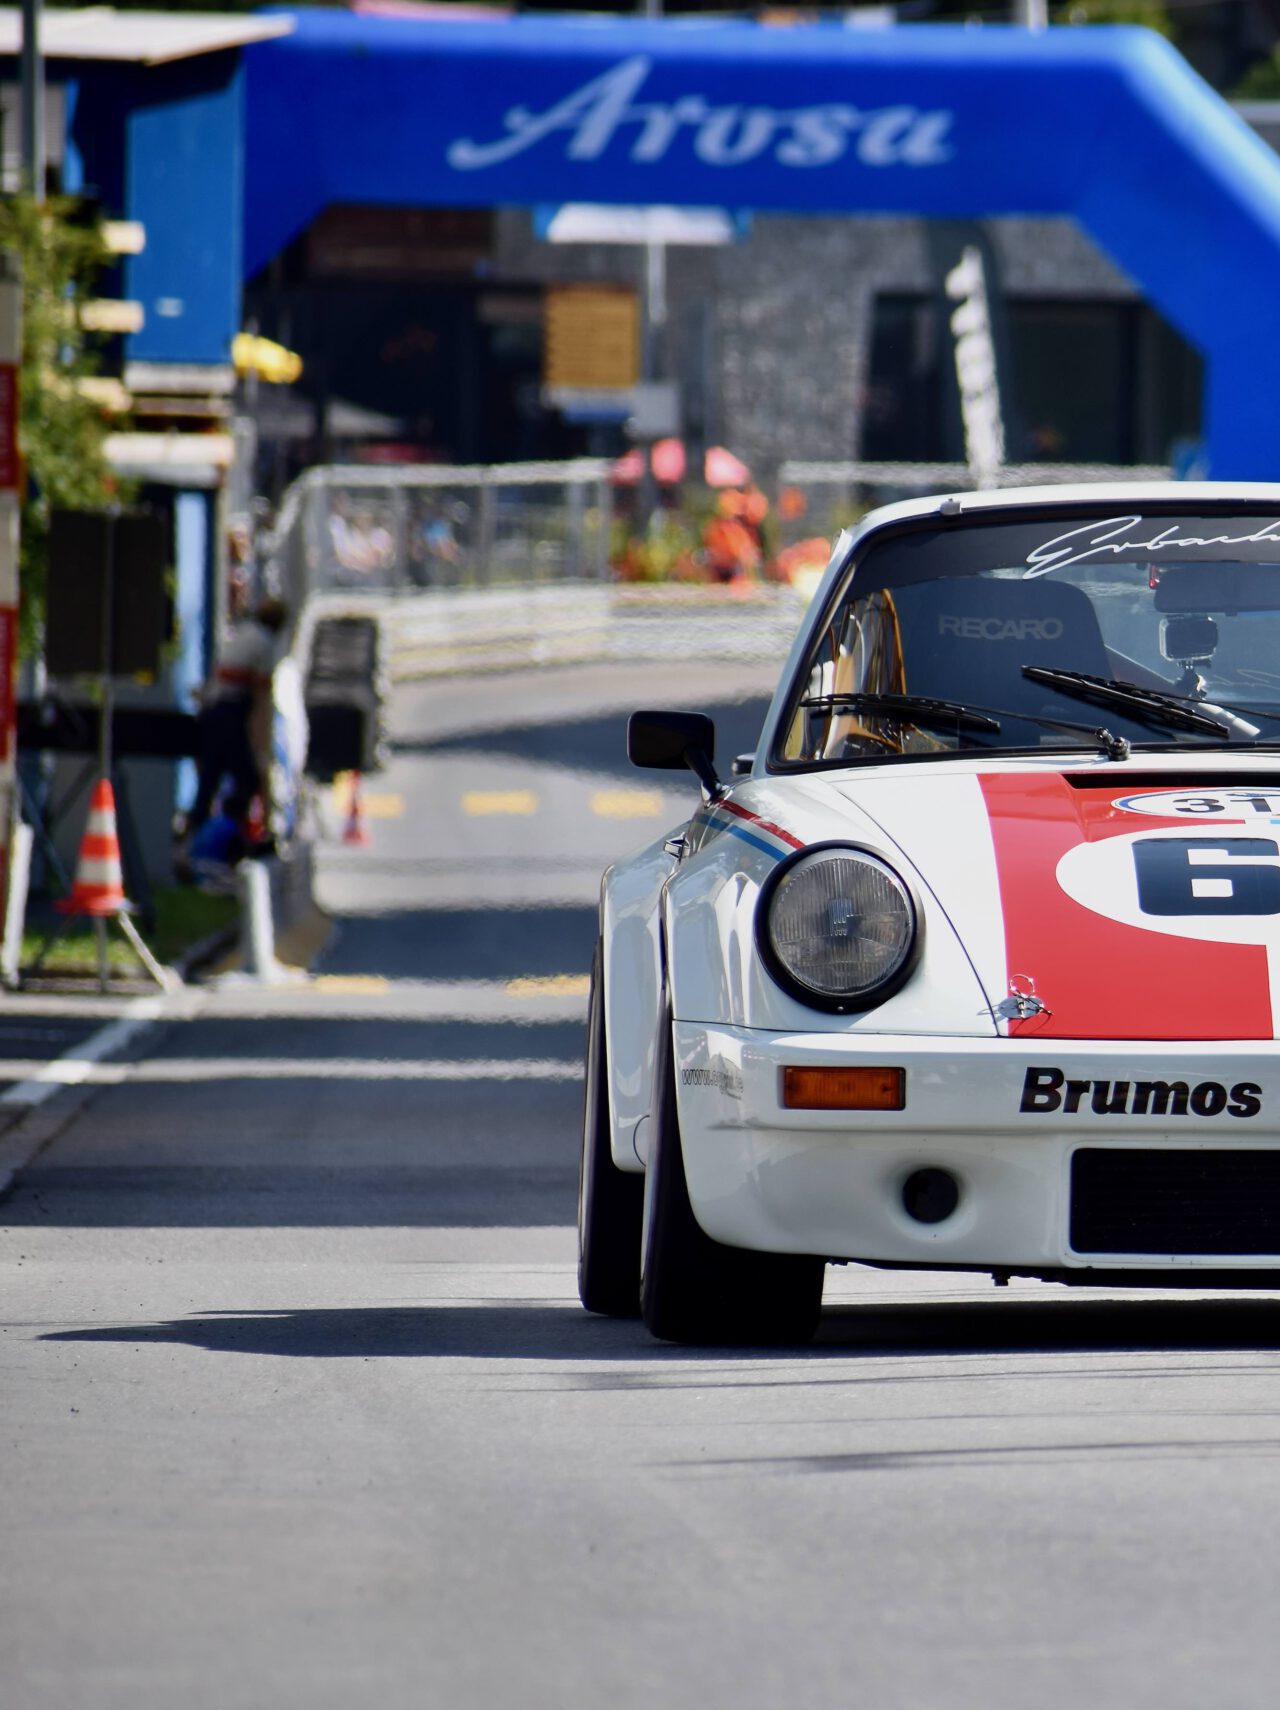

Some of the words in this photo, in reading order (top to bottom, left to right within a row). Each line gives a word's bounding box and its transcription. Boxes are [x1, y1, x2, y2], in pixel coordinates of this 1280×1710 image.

[447, 54, 954, 169] Arosa
[938, 615, 1063, 640] RECARO
[1019, 1066, 1263, 1119] Brumos
